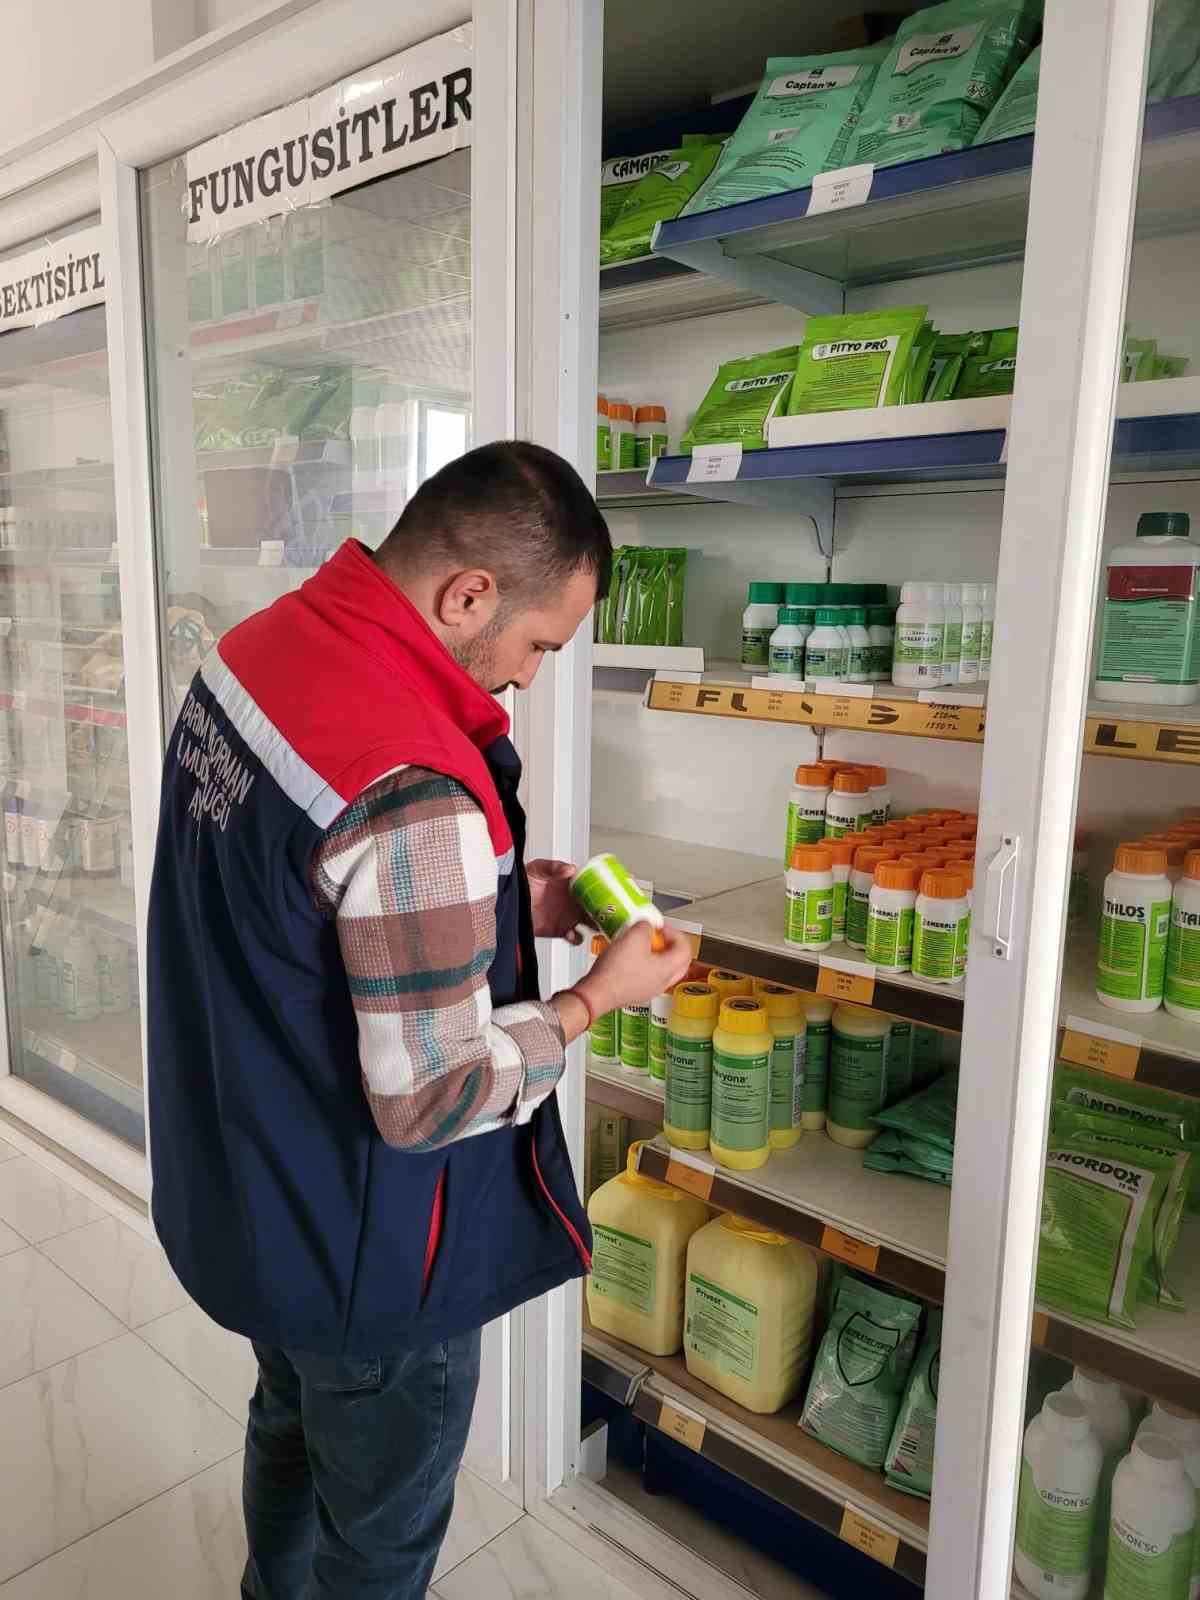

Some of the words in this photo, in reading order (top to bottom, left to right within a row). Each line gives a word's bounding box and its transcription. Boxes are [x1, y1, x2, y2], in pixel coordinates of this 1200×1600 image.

[188, 67, 472, 224] FUNGUSİTLER
[0, 253, 105, 319] EKTİSİTL
[864, 339, 888, 351] PRO
[1056, 1152, 1142, 1188] NORDOX
